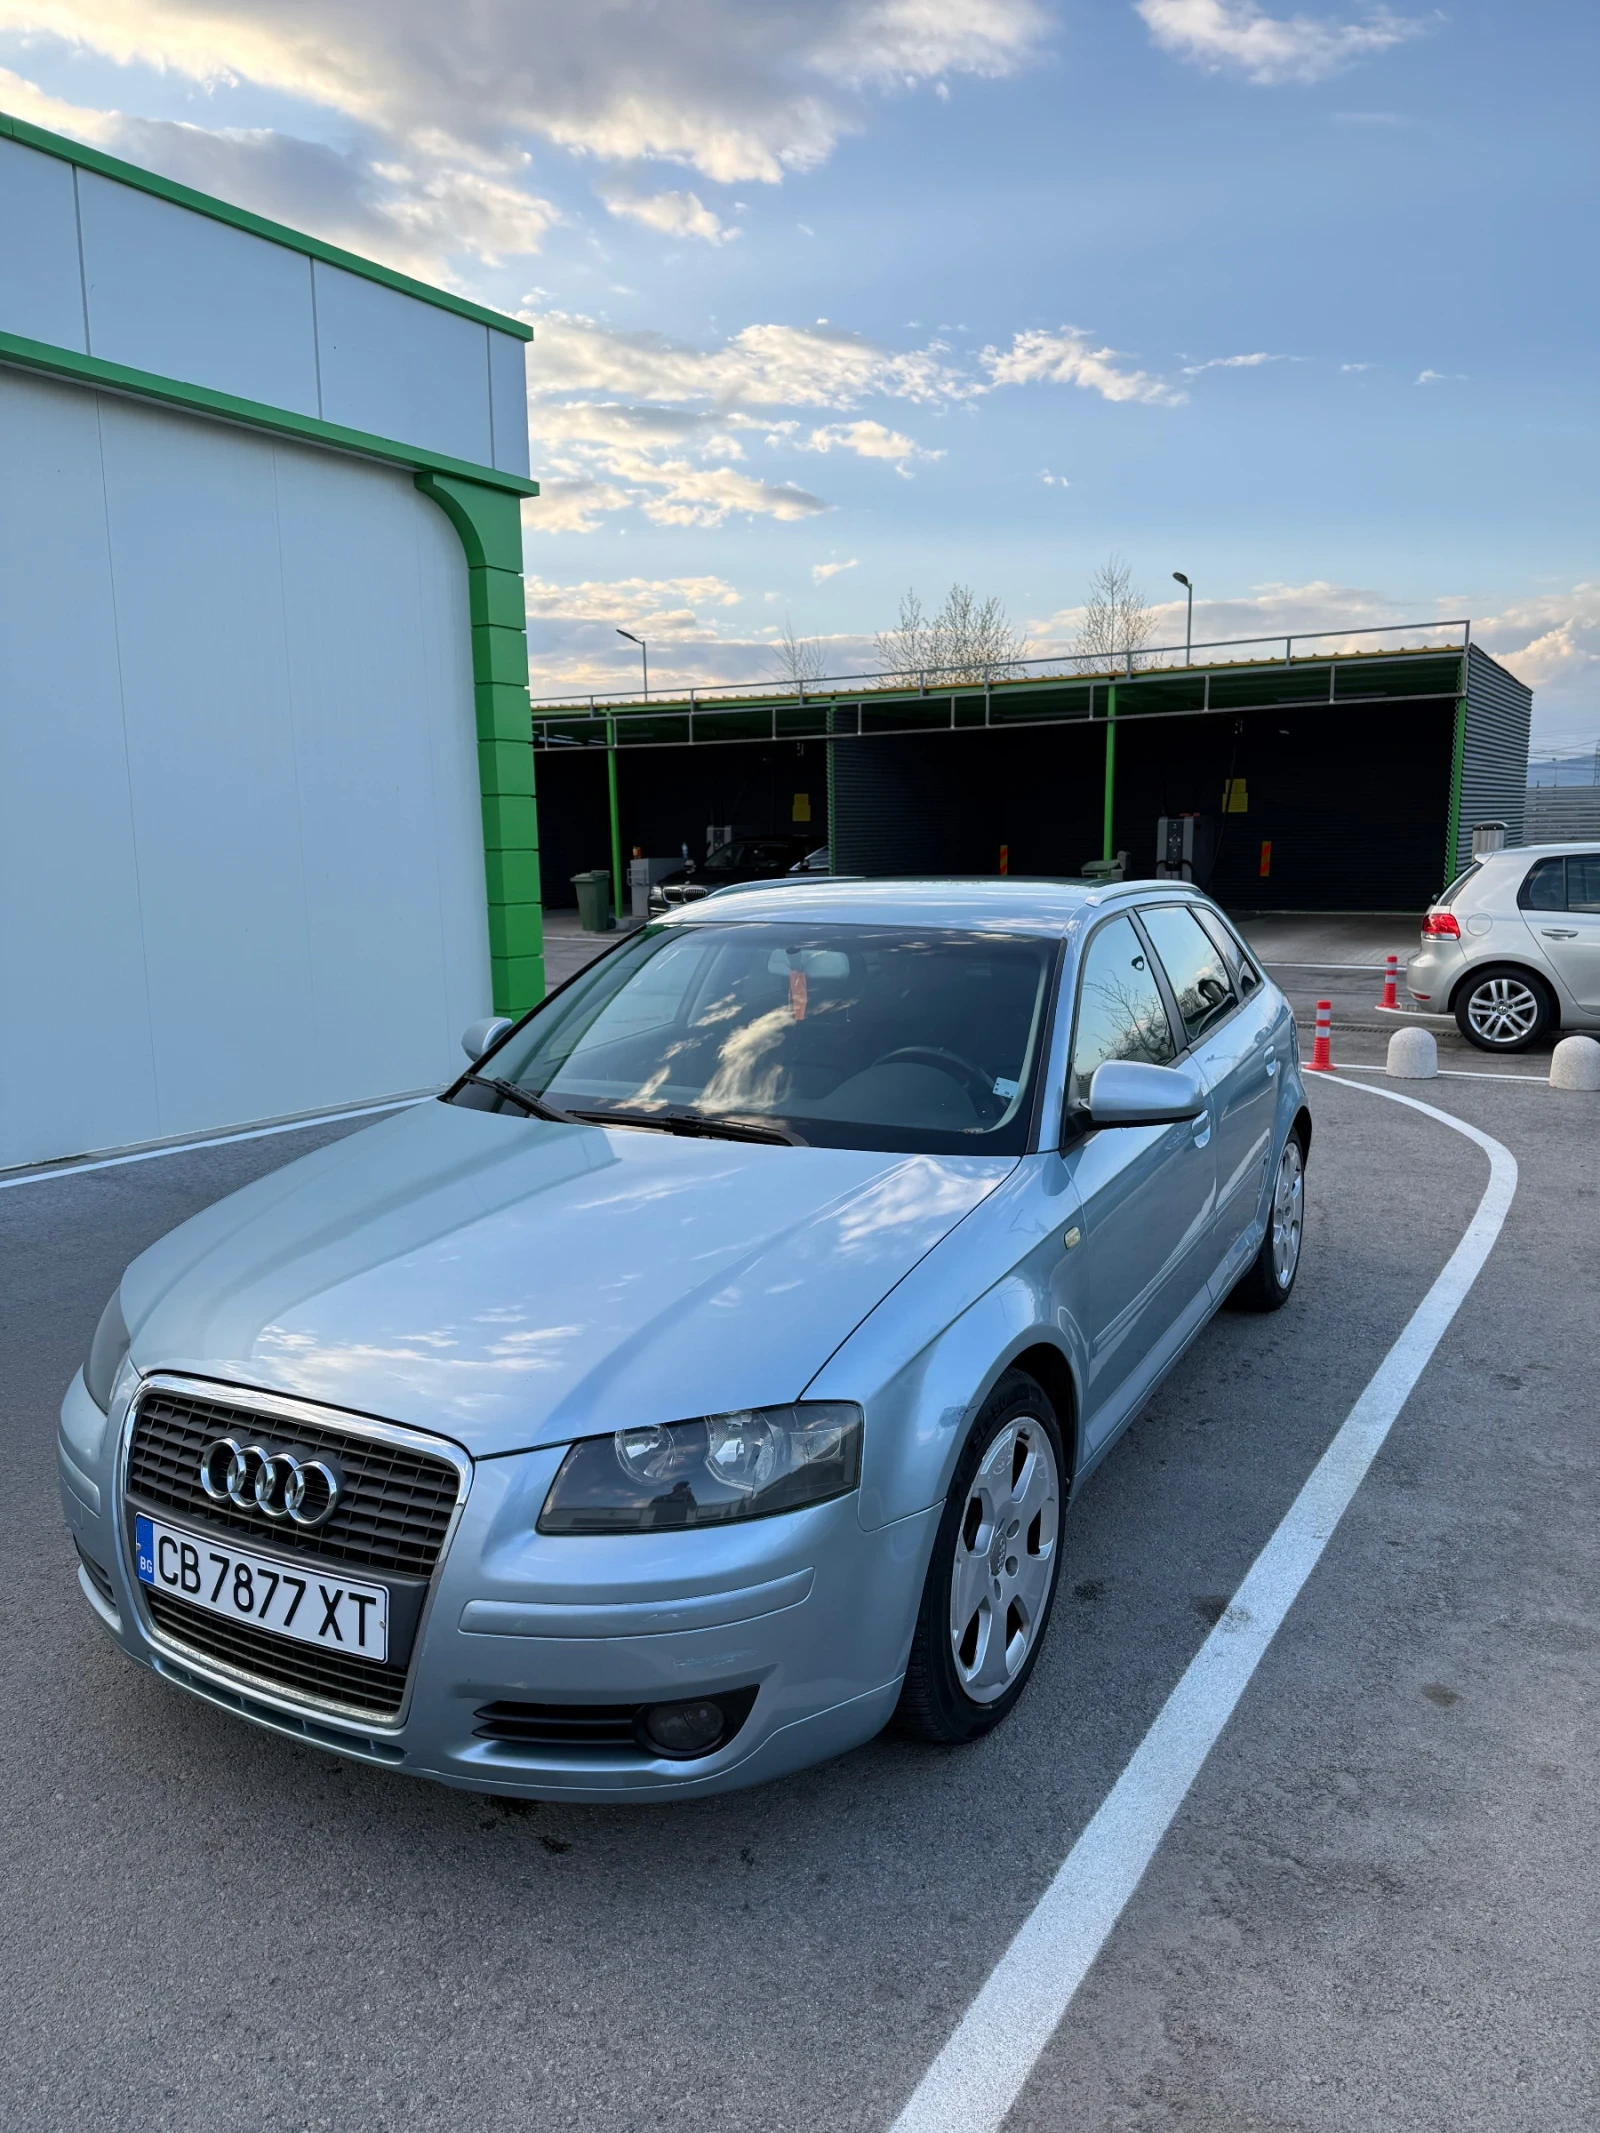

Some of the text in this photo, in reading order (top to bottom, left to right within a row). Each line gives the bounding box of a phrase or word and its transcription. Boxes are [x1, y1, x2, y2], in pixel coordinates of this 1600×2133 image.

[139, 1556, 153, 1574] BG
[158, 1535, 377, 1647] CB 7877 XT
